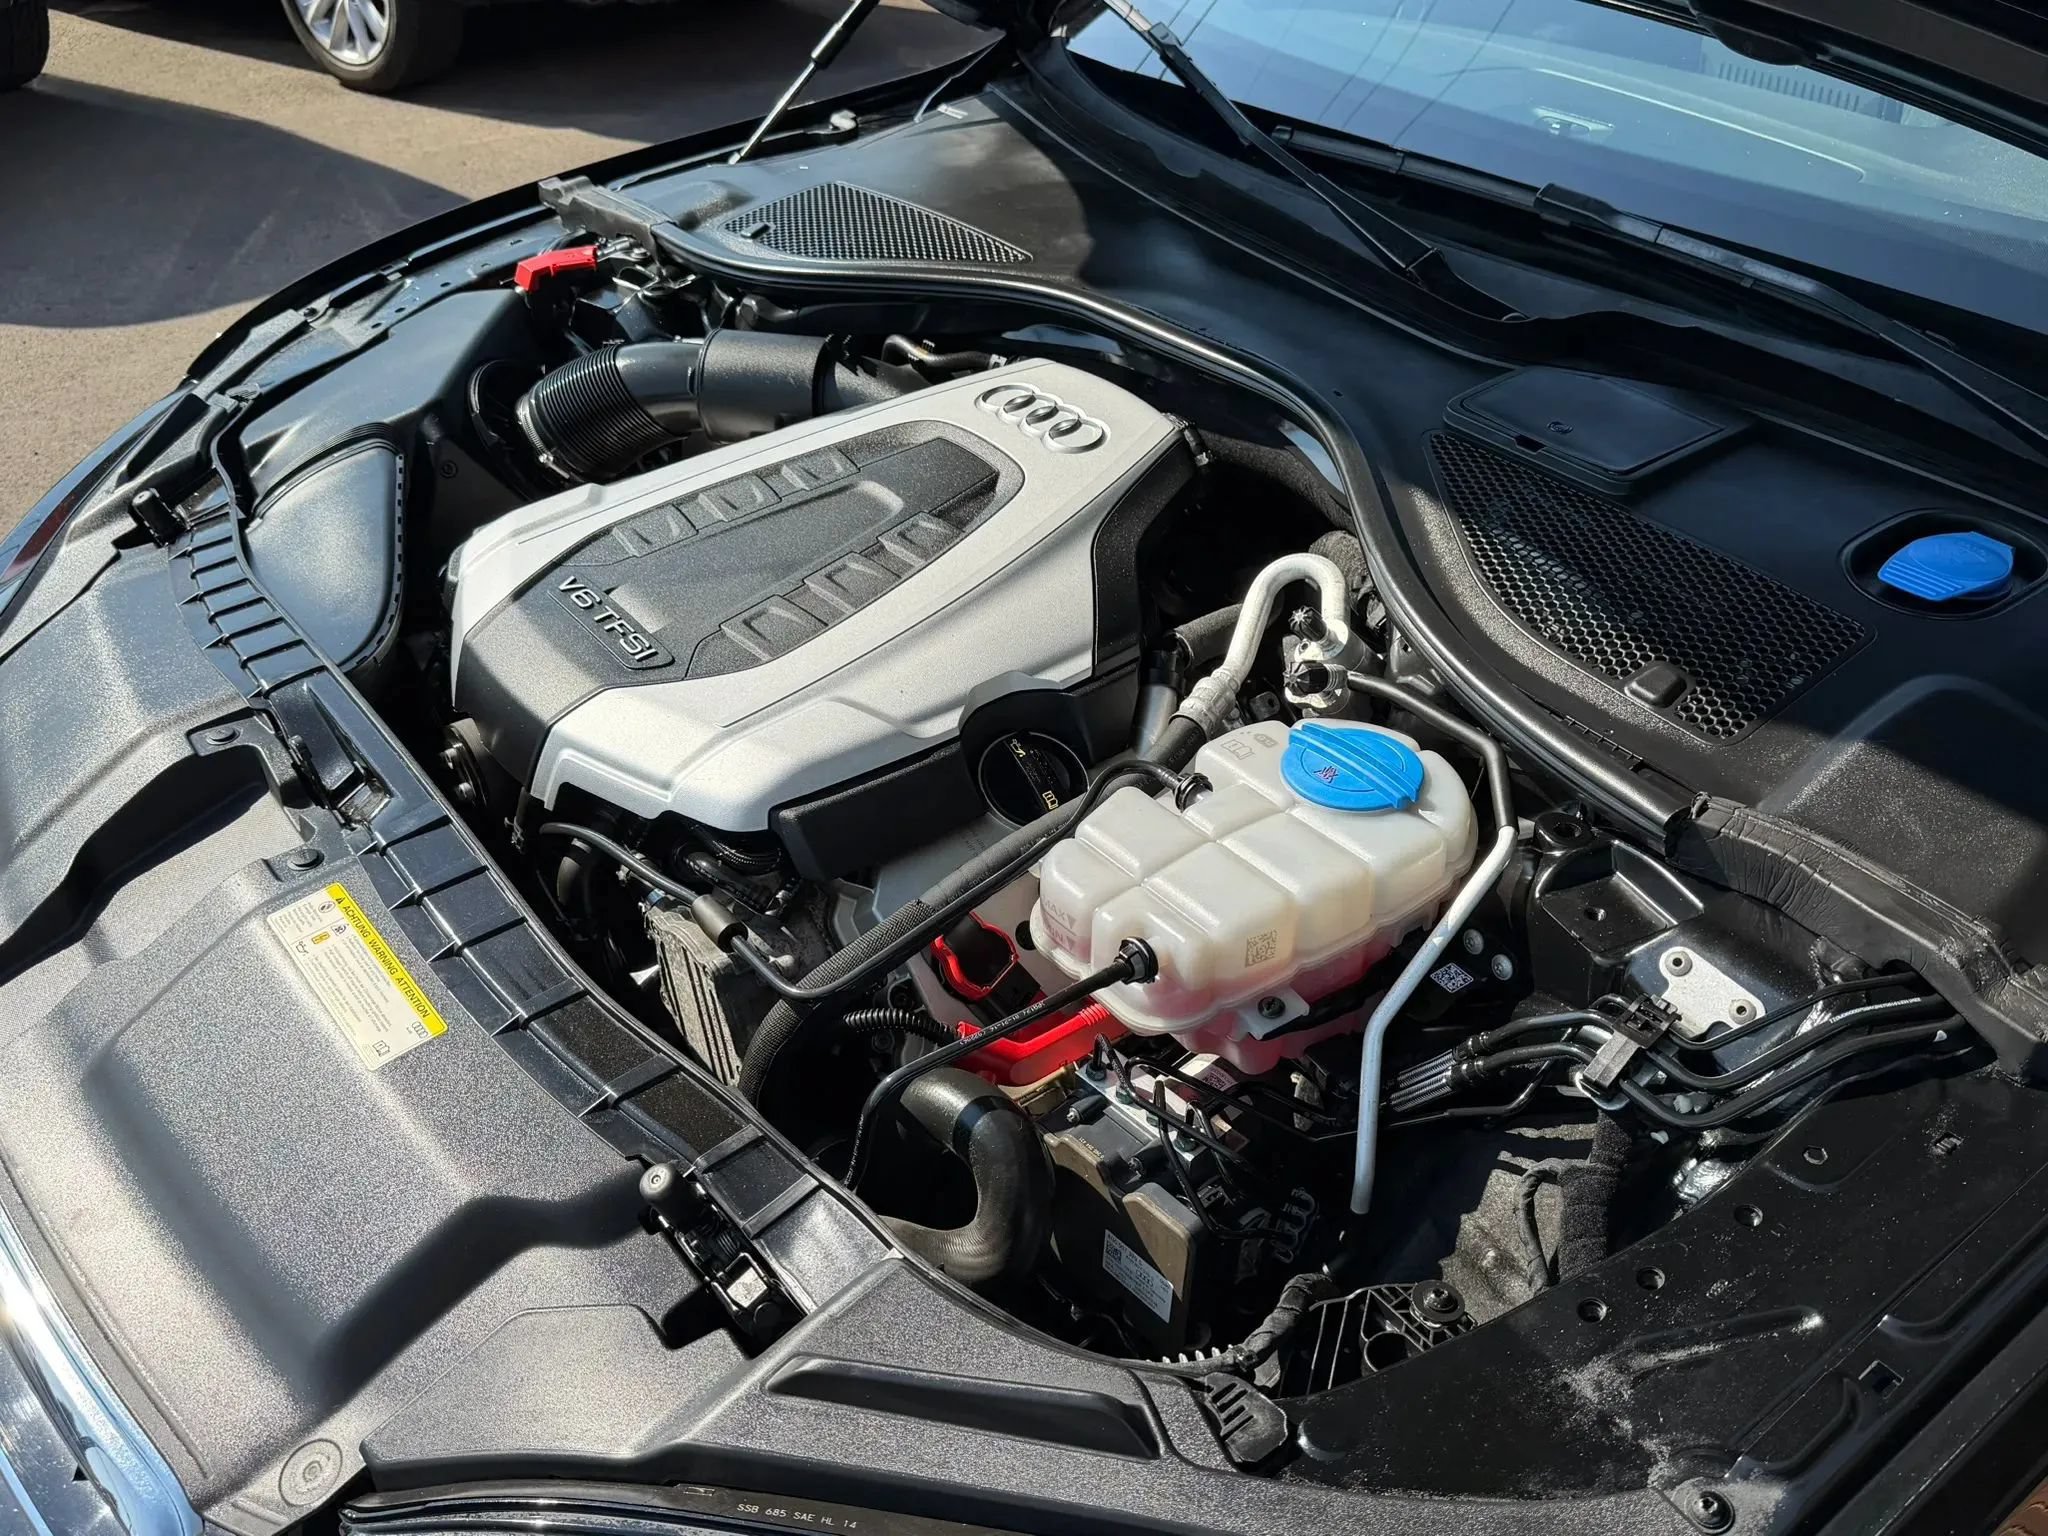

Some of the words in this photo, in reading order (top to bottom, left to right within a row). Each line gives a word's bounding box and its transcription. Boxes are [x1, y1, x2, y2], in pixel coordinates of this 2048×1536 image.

[559, 576, 602, 609] V6
[594, 605, 657, 660] TFSI
[343, 905, 371, 938] ACHTUNG
[368, 938, 398, 975] WARNING
[396, 977, 430, 1018] ATTENTION
[737, 1503, 760, 1514] SSB
[765, 1507, 787, 1518] 685
[793, 1511, 816, 1523] SAE
[821, 1516, 835, 1527] HL
[843, 1519, 857, 1529] 14
